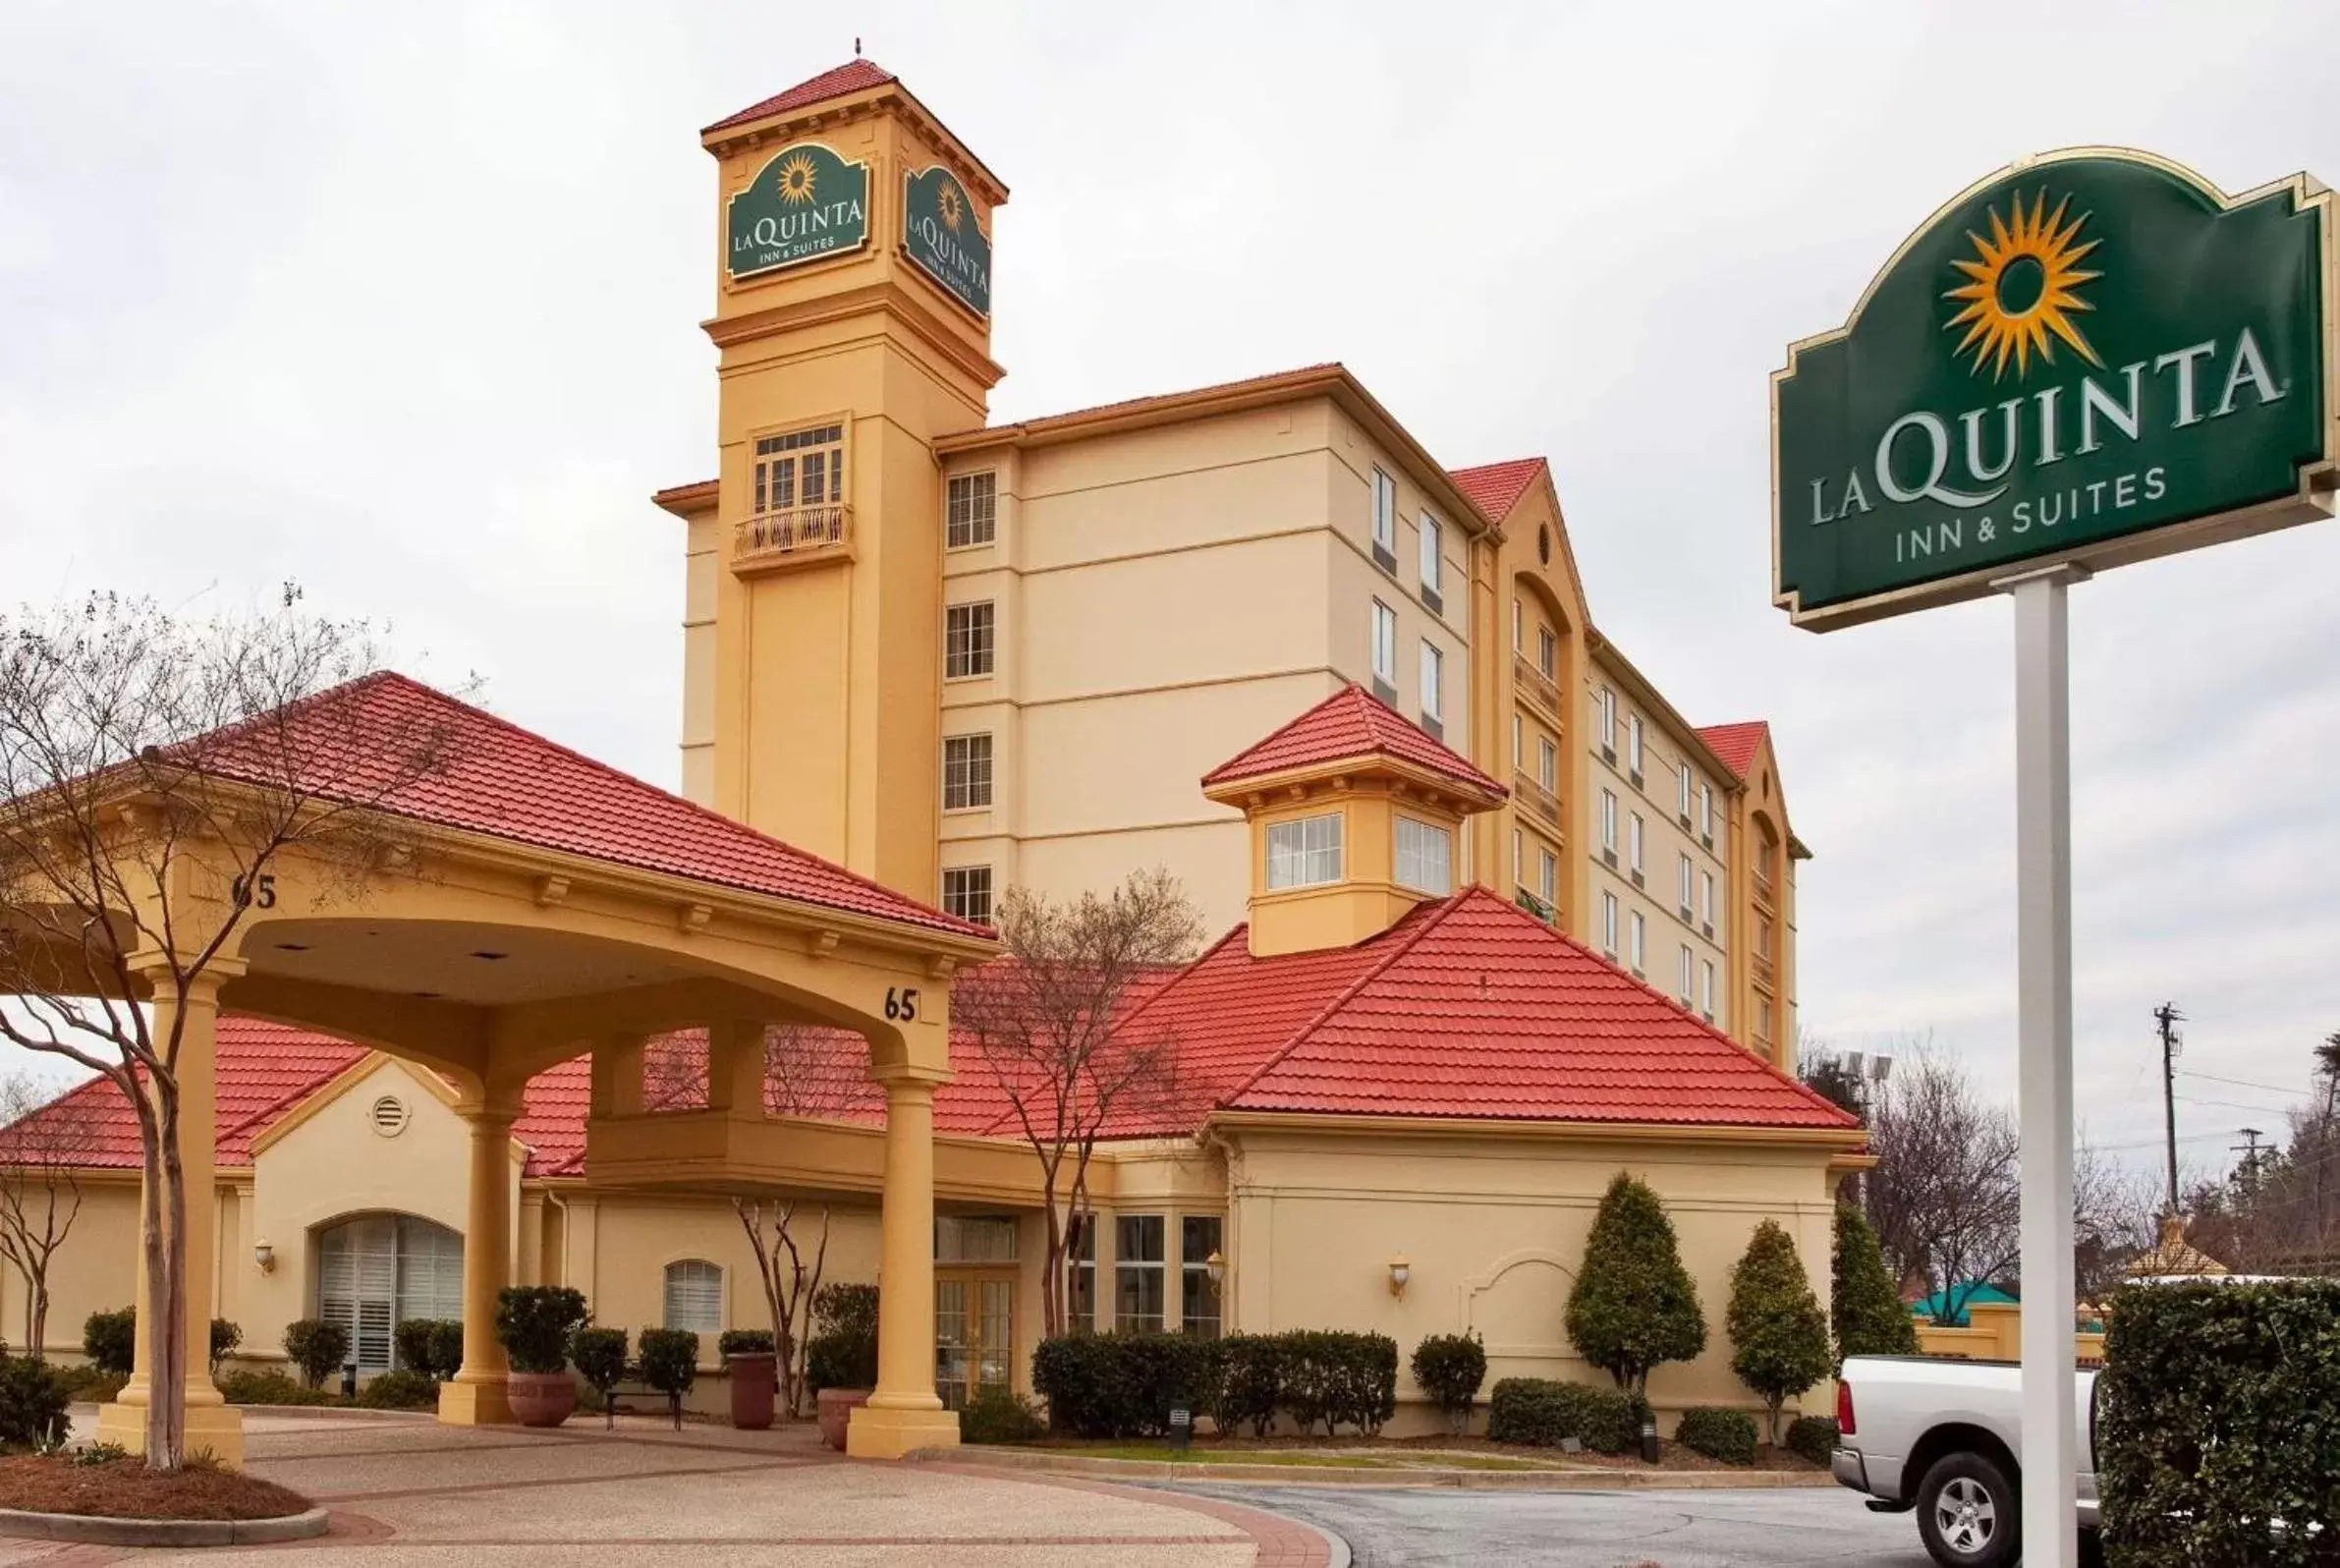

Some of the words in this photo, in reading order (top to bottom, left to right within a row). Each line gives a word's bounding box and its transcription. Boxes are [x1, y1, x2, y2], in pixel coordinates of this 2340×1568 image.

[733, 234, 753, 252] LA
[753, 198, 863, 248] QUINTA
[759, 251, 781, 264] INN
[793, 236, 835, 256] SUITES
[909, 212, 922, 237] LA
[922, 216, 988, 295] QUINTA
[1810, 466, 1876, 527] LA
[1874, 326, 2288, 508] QUINTA
[1896, 517, 1963, 563] INN
[1978, 516, 1997, 542] &
[2012, 467, 2166, 533] SUITES
[232, 874, 276, 910] 65
[885, 986, 918, 1023] 65
